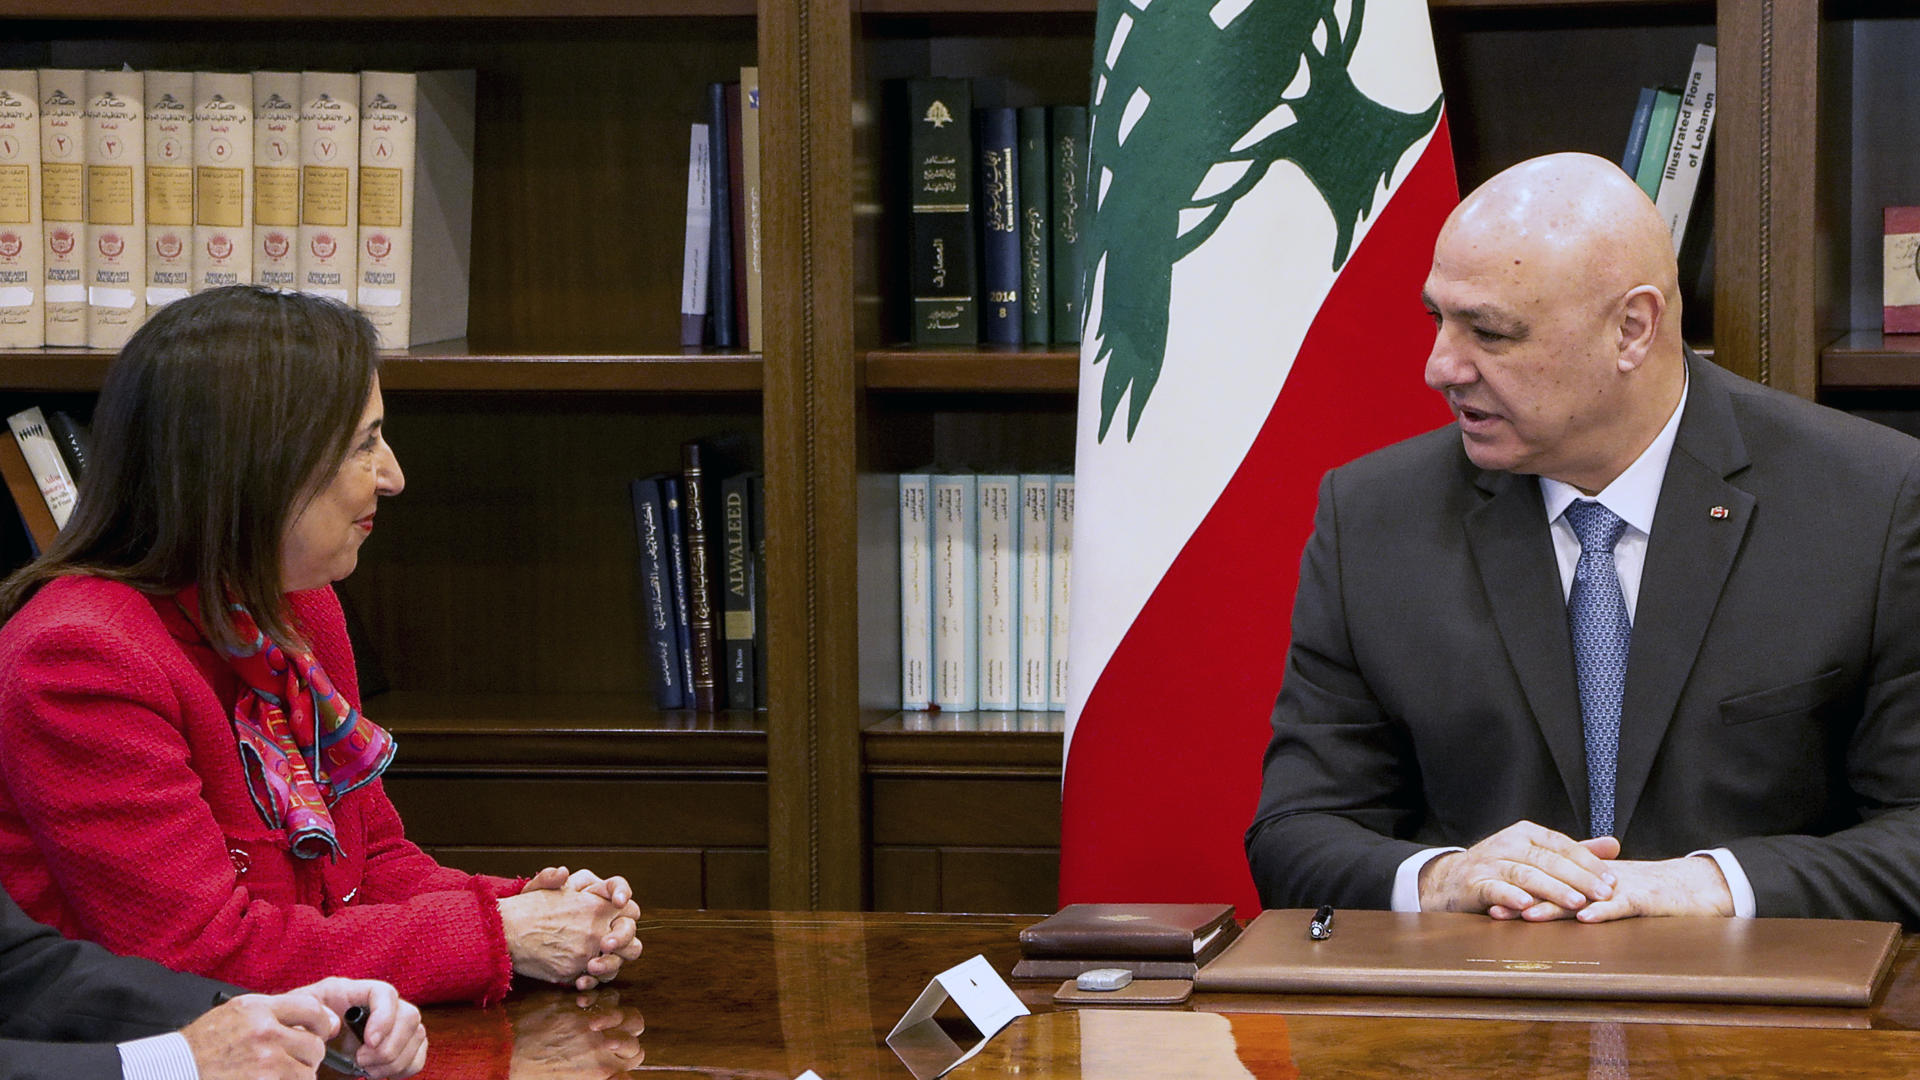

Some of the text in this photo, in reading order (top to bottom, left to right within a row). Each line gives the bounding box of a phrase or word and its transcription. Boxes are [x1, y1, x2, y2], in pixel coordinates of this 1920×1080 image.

[1665, 72, 1702, 180] Illustrated Flora
[1689, 93, 1715, 168] of Lebanon
[990, 291, 1016, 303] 2014
[999, 307, 1007, 318] 8
[727, 493, 744, 597] ALWALEED
